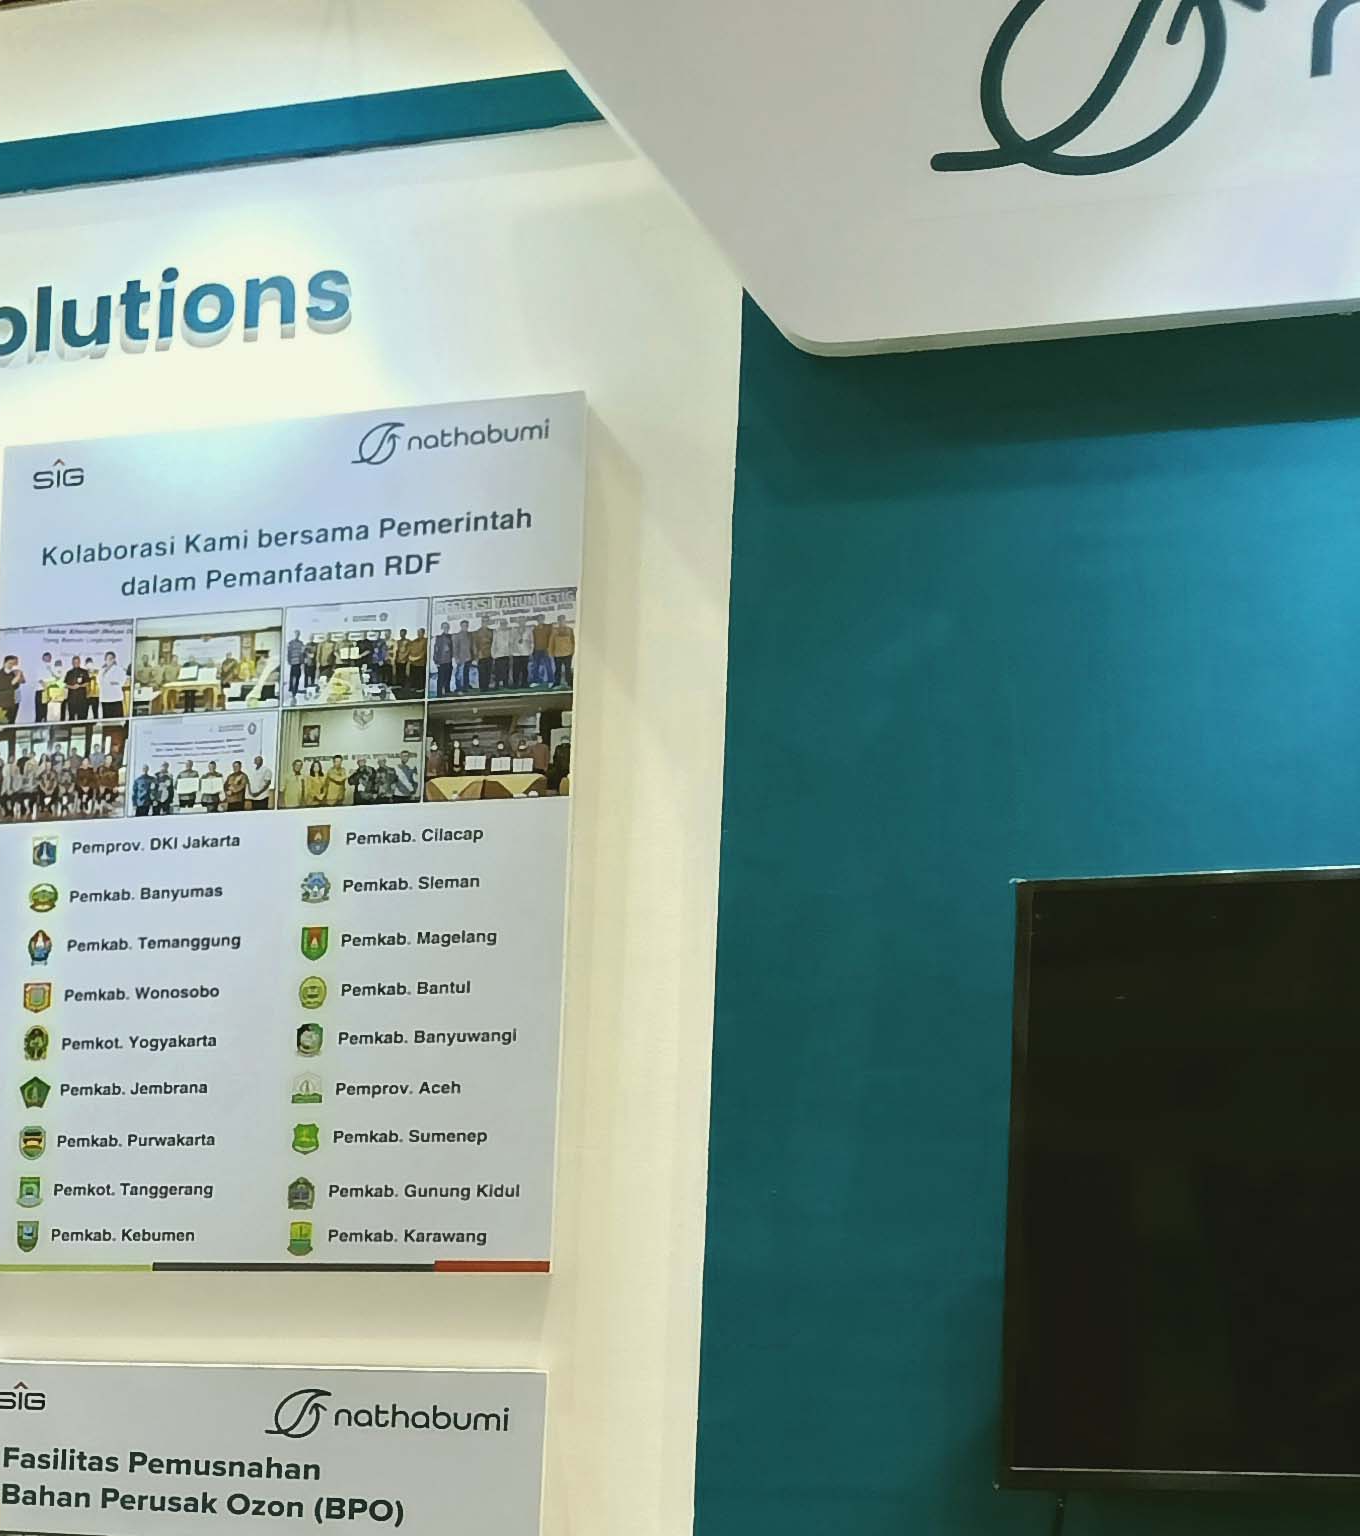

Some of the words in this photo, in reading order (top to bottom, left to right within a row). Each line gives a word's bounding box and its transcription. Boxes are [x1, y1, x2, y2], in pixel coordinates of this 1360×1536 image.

[407, 419, 550, 452] nathabumi
[32, 459, 84, 490] SIG
[42, 537, 176, 566] Kolaborasi
[184, 530, 250, 554] Kami
[258, 522, 370, 548] bersama
[379, 508, 532, 540] Pemerintah
[121, 572, 196, 596] dalam
[206, 559, 375, 590] Pemanfaatan
[384, 553, 442, 576] RDF
[72, 840, 145, 856] Pemprov.
[150, 835, 179, 850] DKI
[182, 834, 240, 850] Jakarta
[346, 829, 416, 845] Pemkab.
[421, 826, 484, 845] Cilacap
[69, 887, 135, 904] Pemkab.
[140, 884, 224, 902] Banyumas
[342, 878, 411, 892] Pemkab.
[416, 874, 480, 890] Sleman
[66, 936, 133, 952] Pemkab.
[138, 933, 242, 951] Temanggung
[341, 932, 412, 948] Pemkab.
[416, 929, 498, 948] Magelang
[64, 986, 130, 1002] Pemkab.
[134, 984, 220, 1000] Wonosobo
[62, 1036, 124, 1051] Pemkot.
[128, 1034, 217, 1052] Yogyakarta
[334, 1405, 509, 1431] nathabumi
[3, 1447, 119, 1473] Fasilitas
[128, 1452, 321, 1481] Pemusnahan
[2, 1484, 91, 1509] Bahan
[100, 1488, 217, 1516] Perusak
[227, 1494, 304, 1519] Ozon
[314, 1497, 404, 1528] (BPO)
